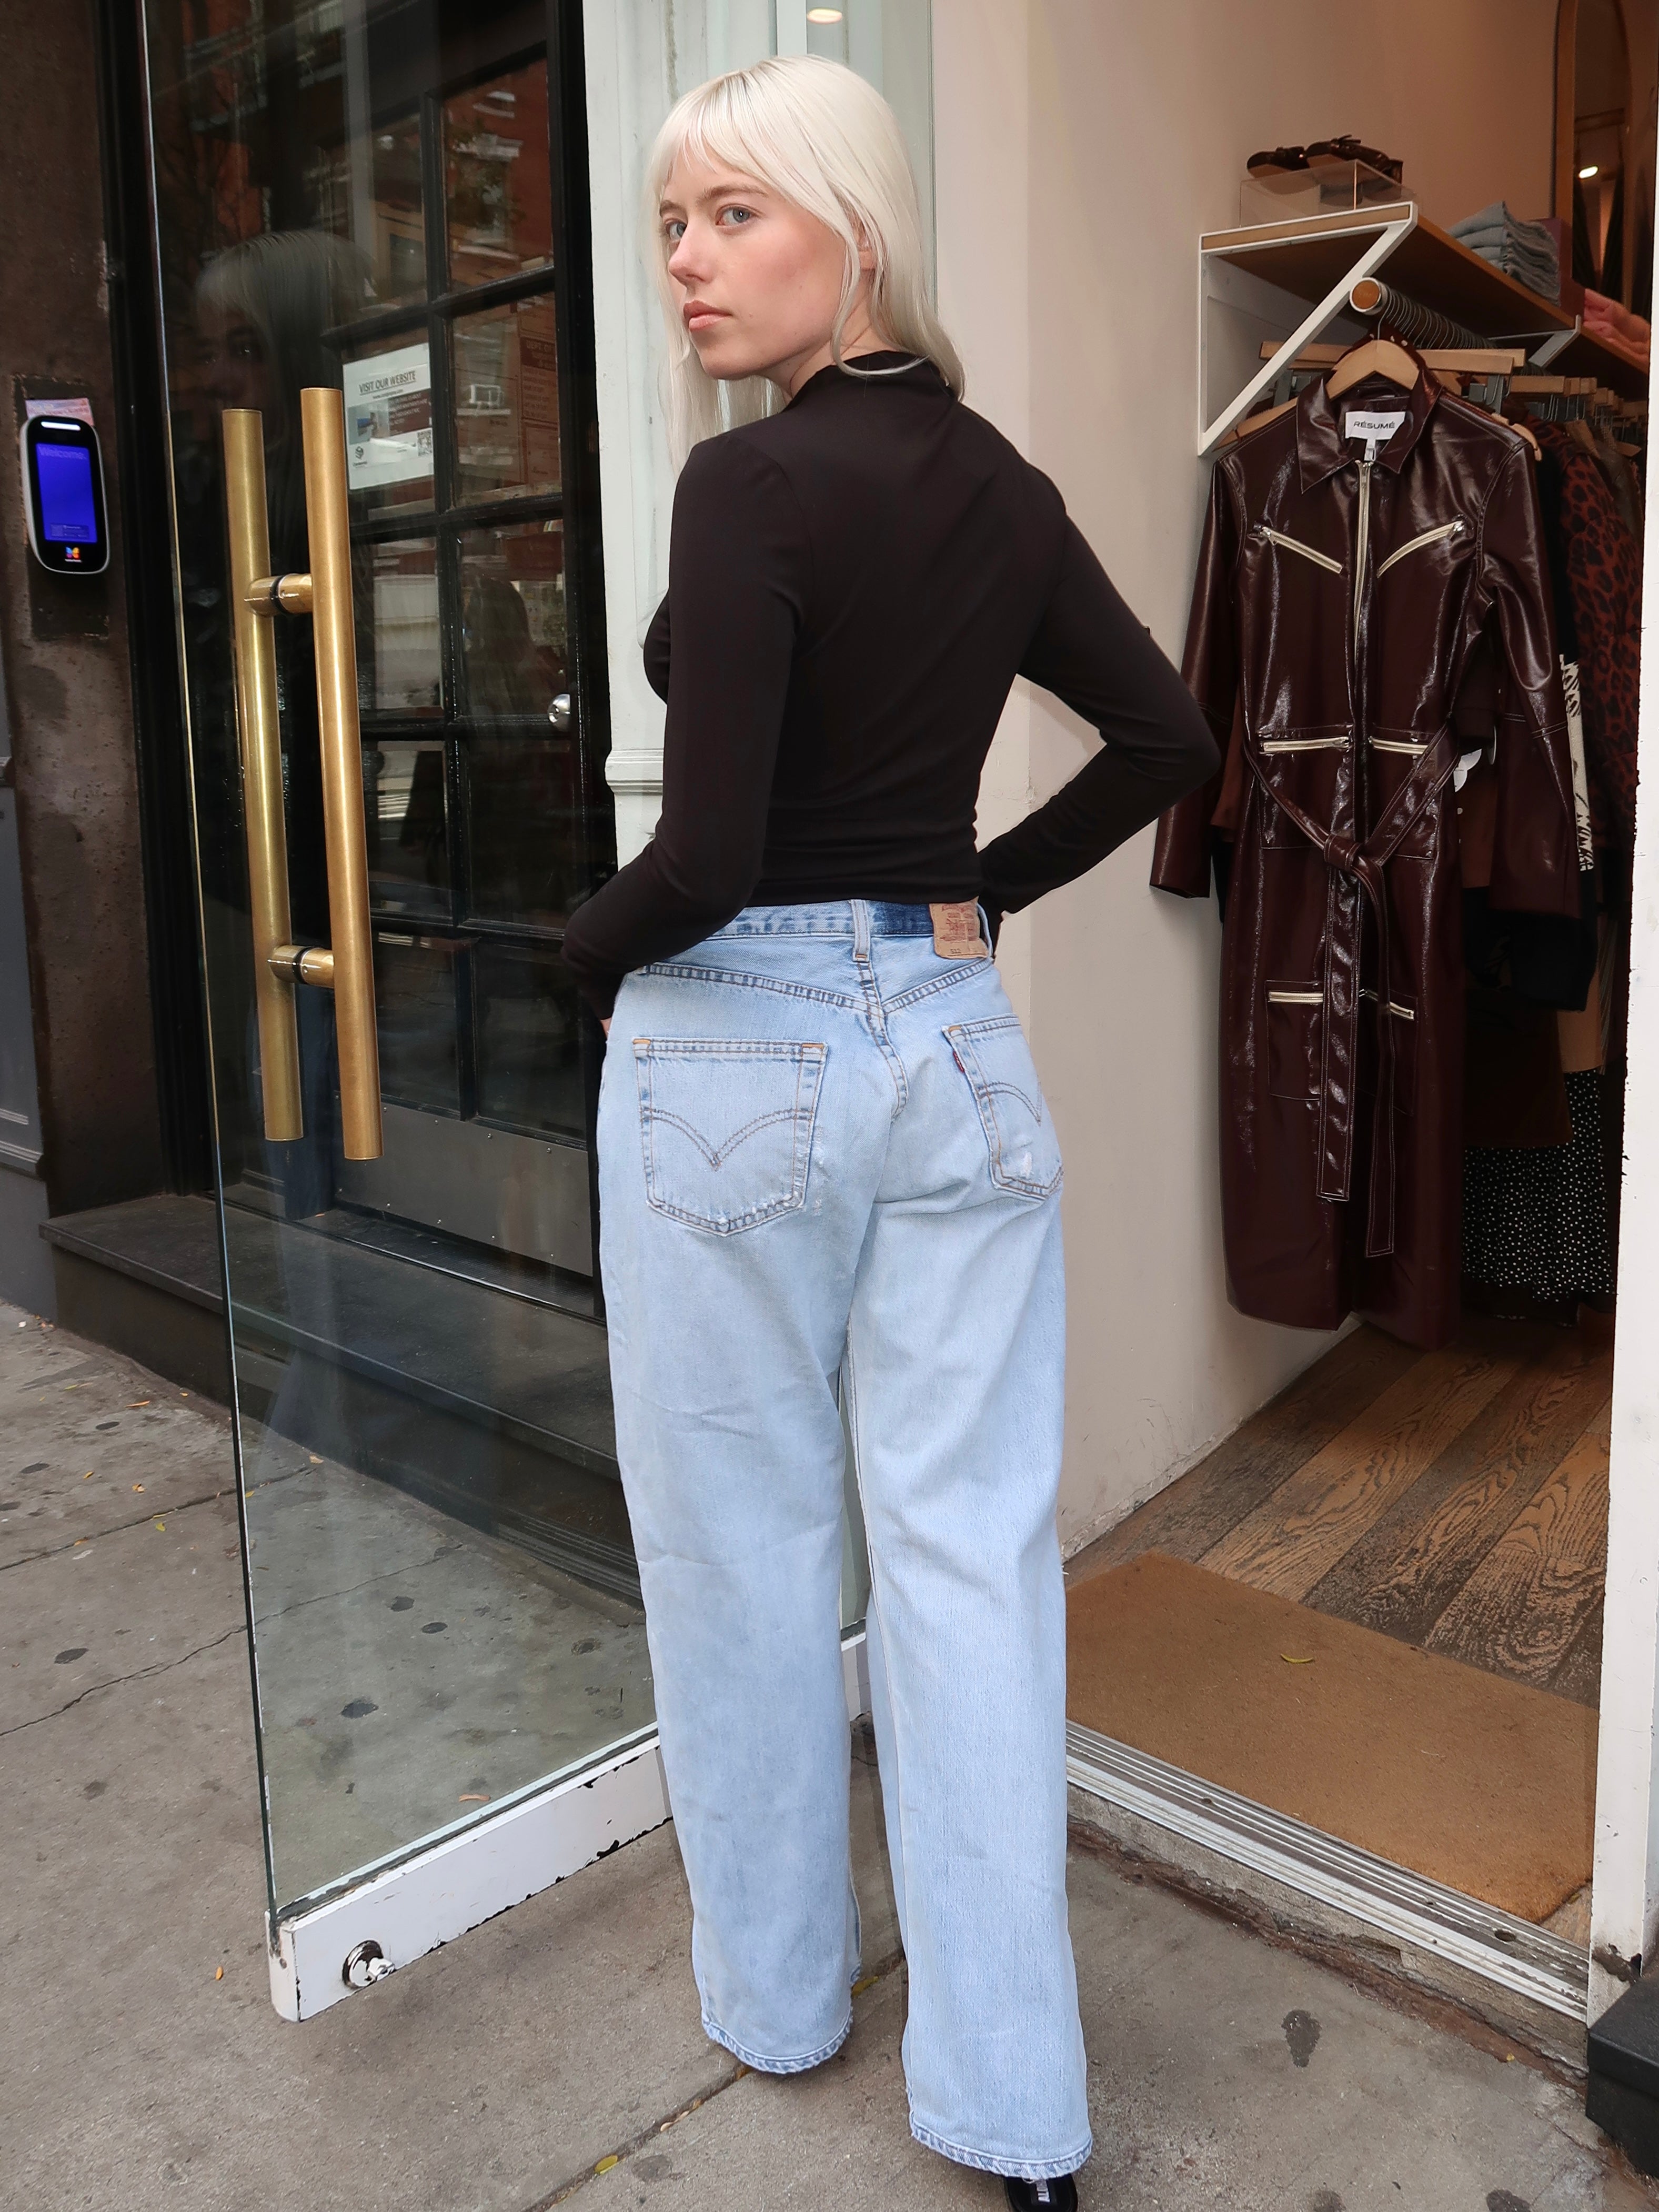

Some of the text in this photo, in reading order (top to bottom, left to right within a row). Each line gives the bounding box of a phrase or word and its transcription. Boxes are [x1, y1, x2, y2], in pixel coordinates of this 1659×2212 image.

[359, 370, 416, 393] VISIT OUR WEBSITE
[1353, 420, 1395, 429] RÉSUMÉ
